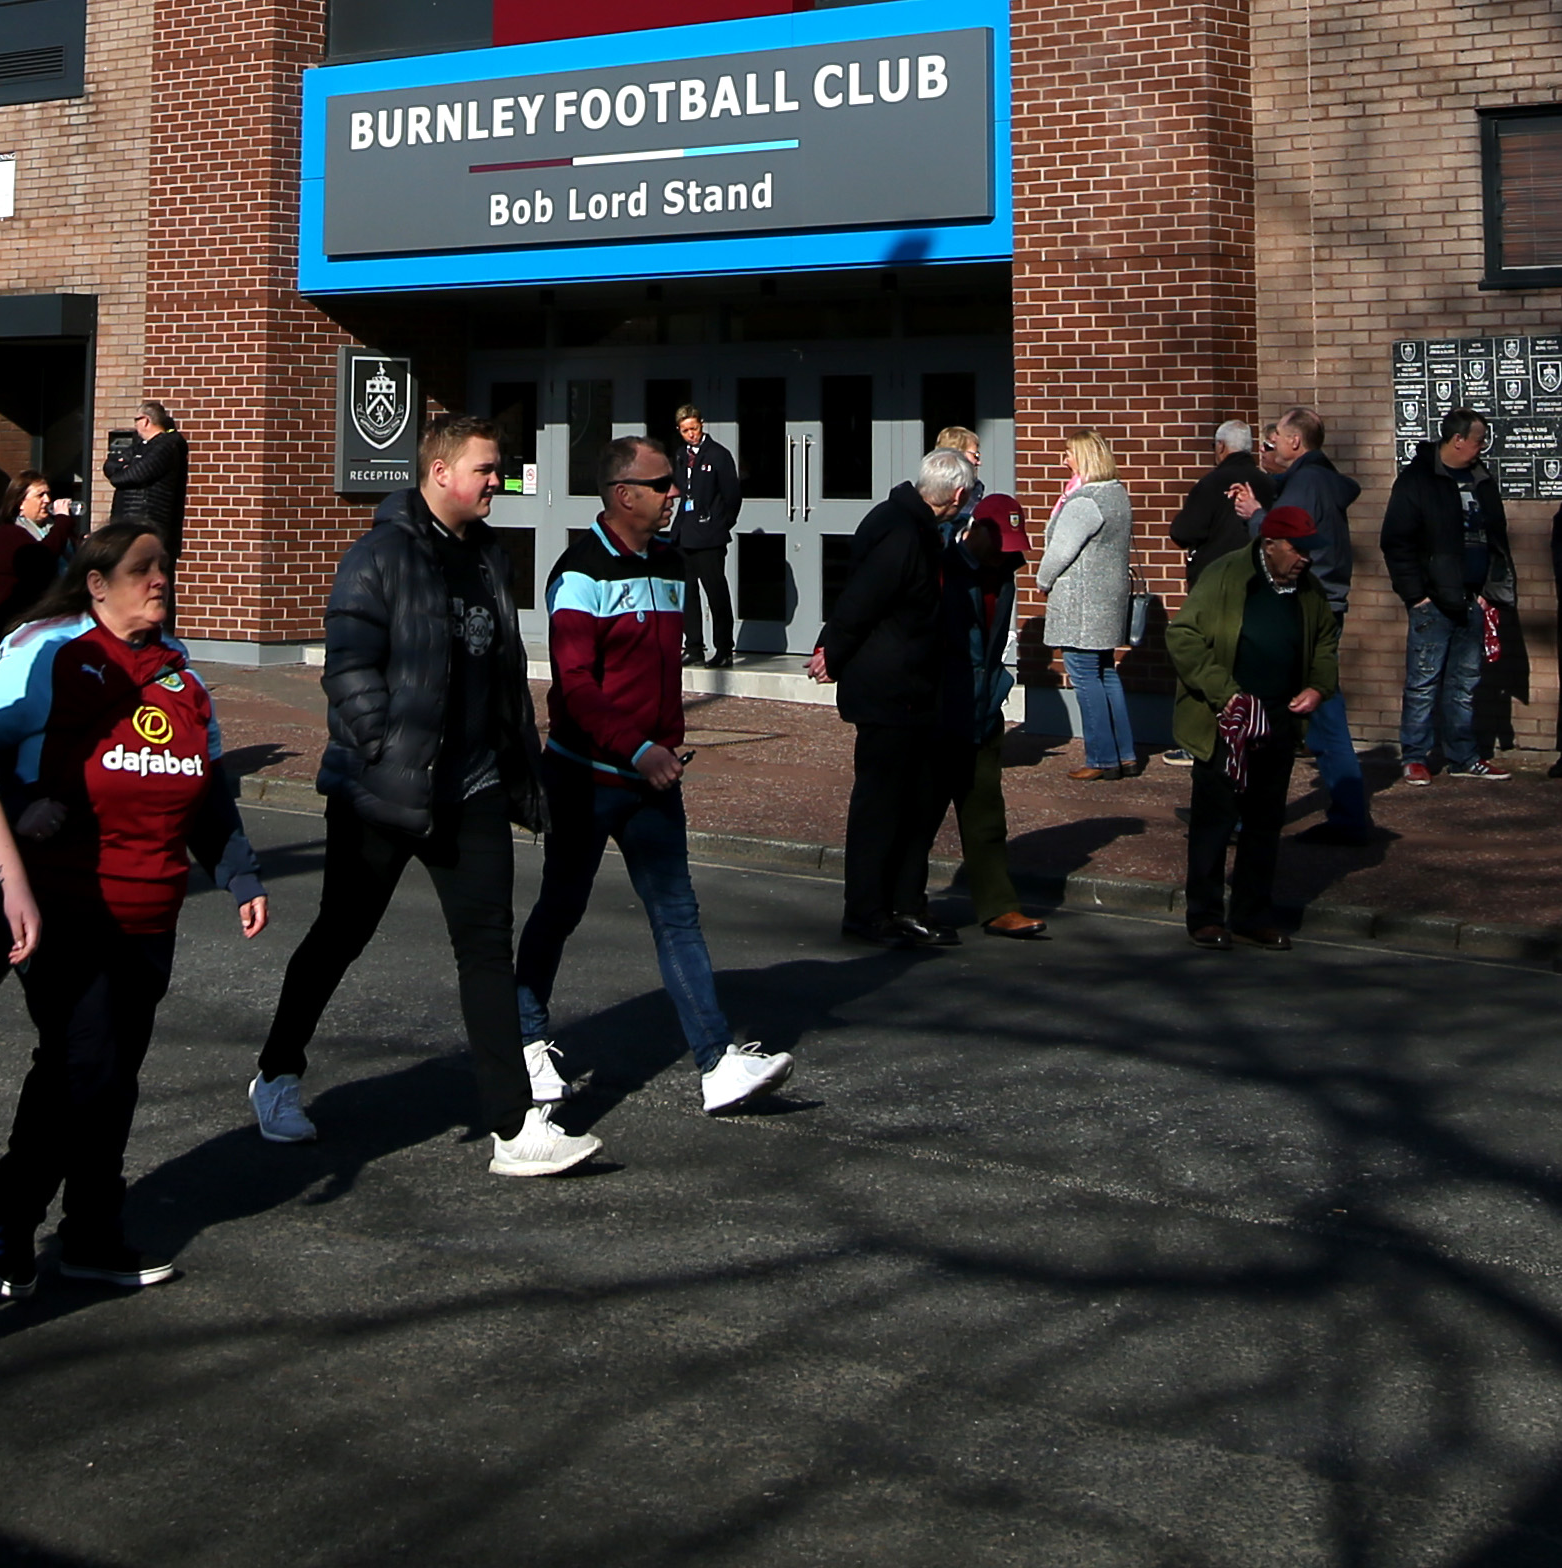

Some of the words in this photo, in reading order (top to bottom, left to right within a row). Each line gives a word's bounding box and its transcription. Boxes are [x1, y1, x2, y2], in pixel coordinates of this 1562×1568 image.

[350, 93, 546, 151] BURNLEY
[555, 69, 800, 132] FOOTBALL
[814, 54, 949, 109] CLUB
[489, 187, 553, 228] Bob
[567, 180, 648, 221] Lord
[662, 173, 773, 216] Stand
[350, 470, 409, 480] RECEPTION
[102, 744, 203, 777] dafabet
